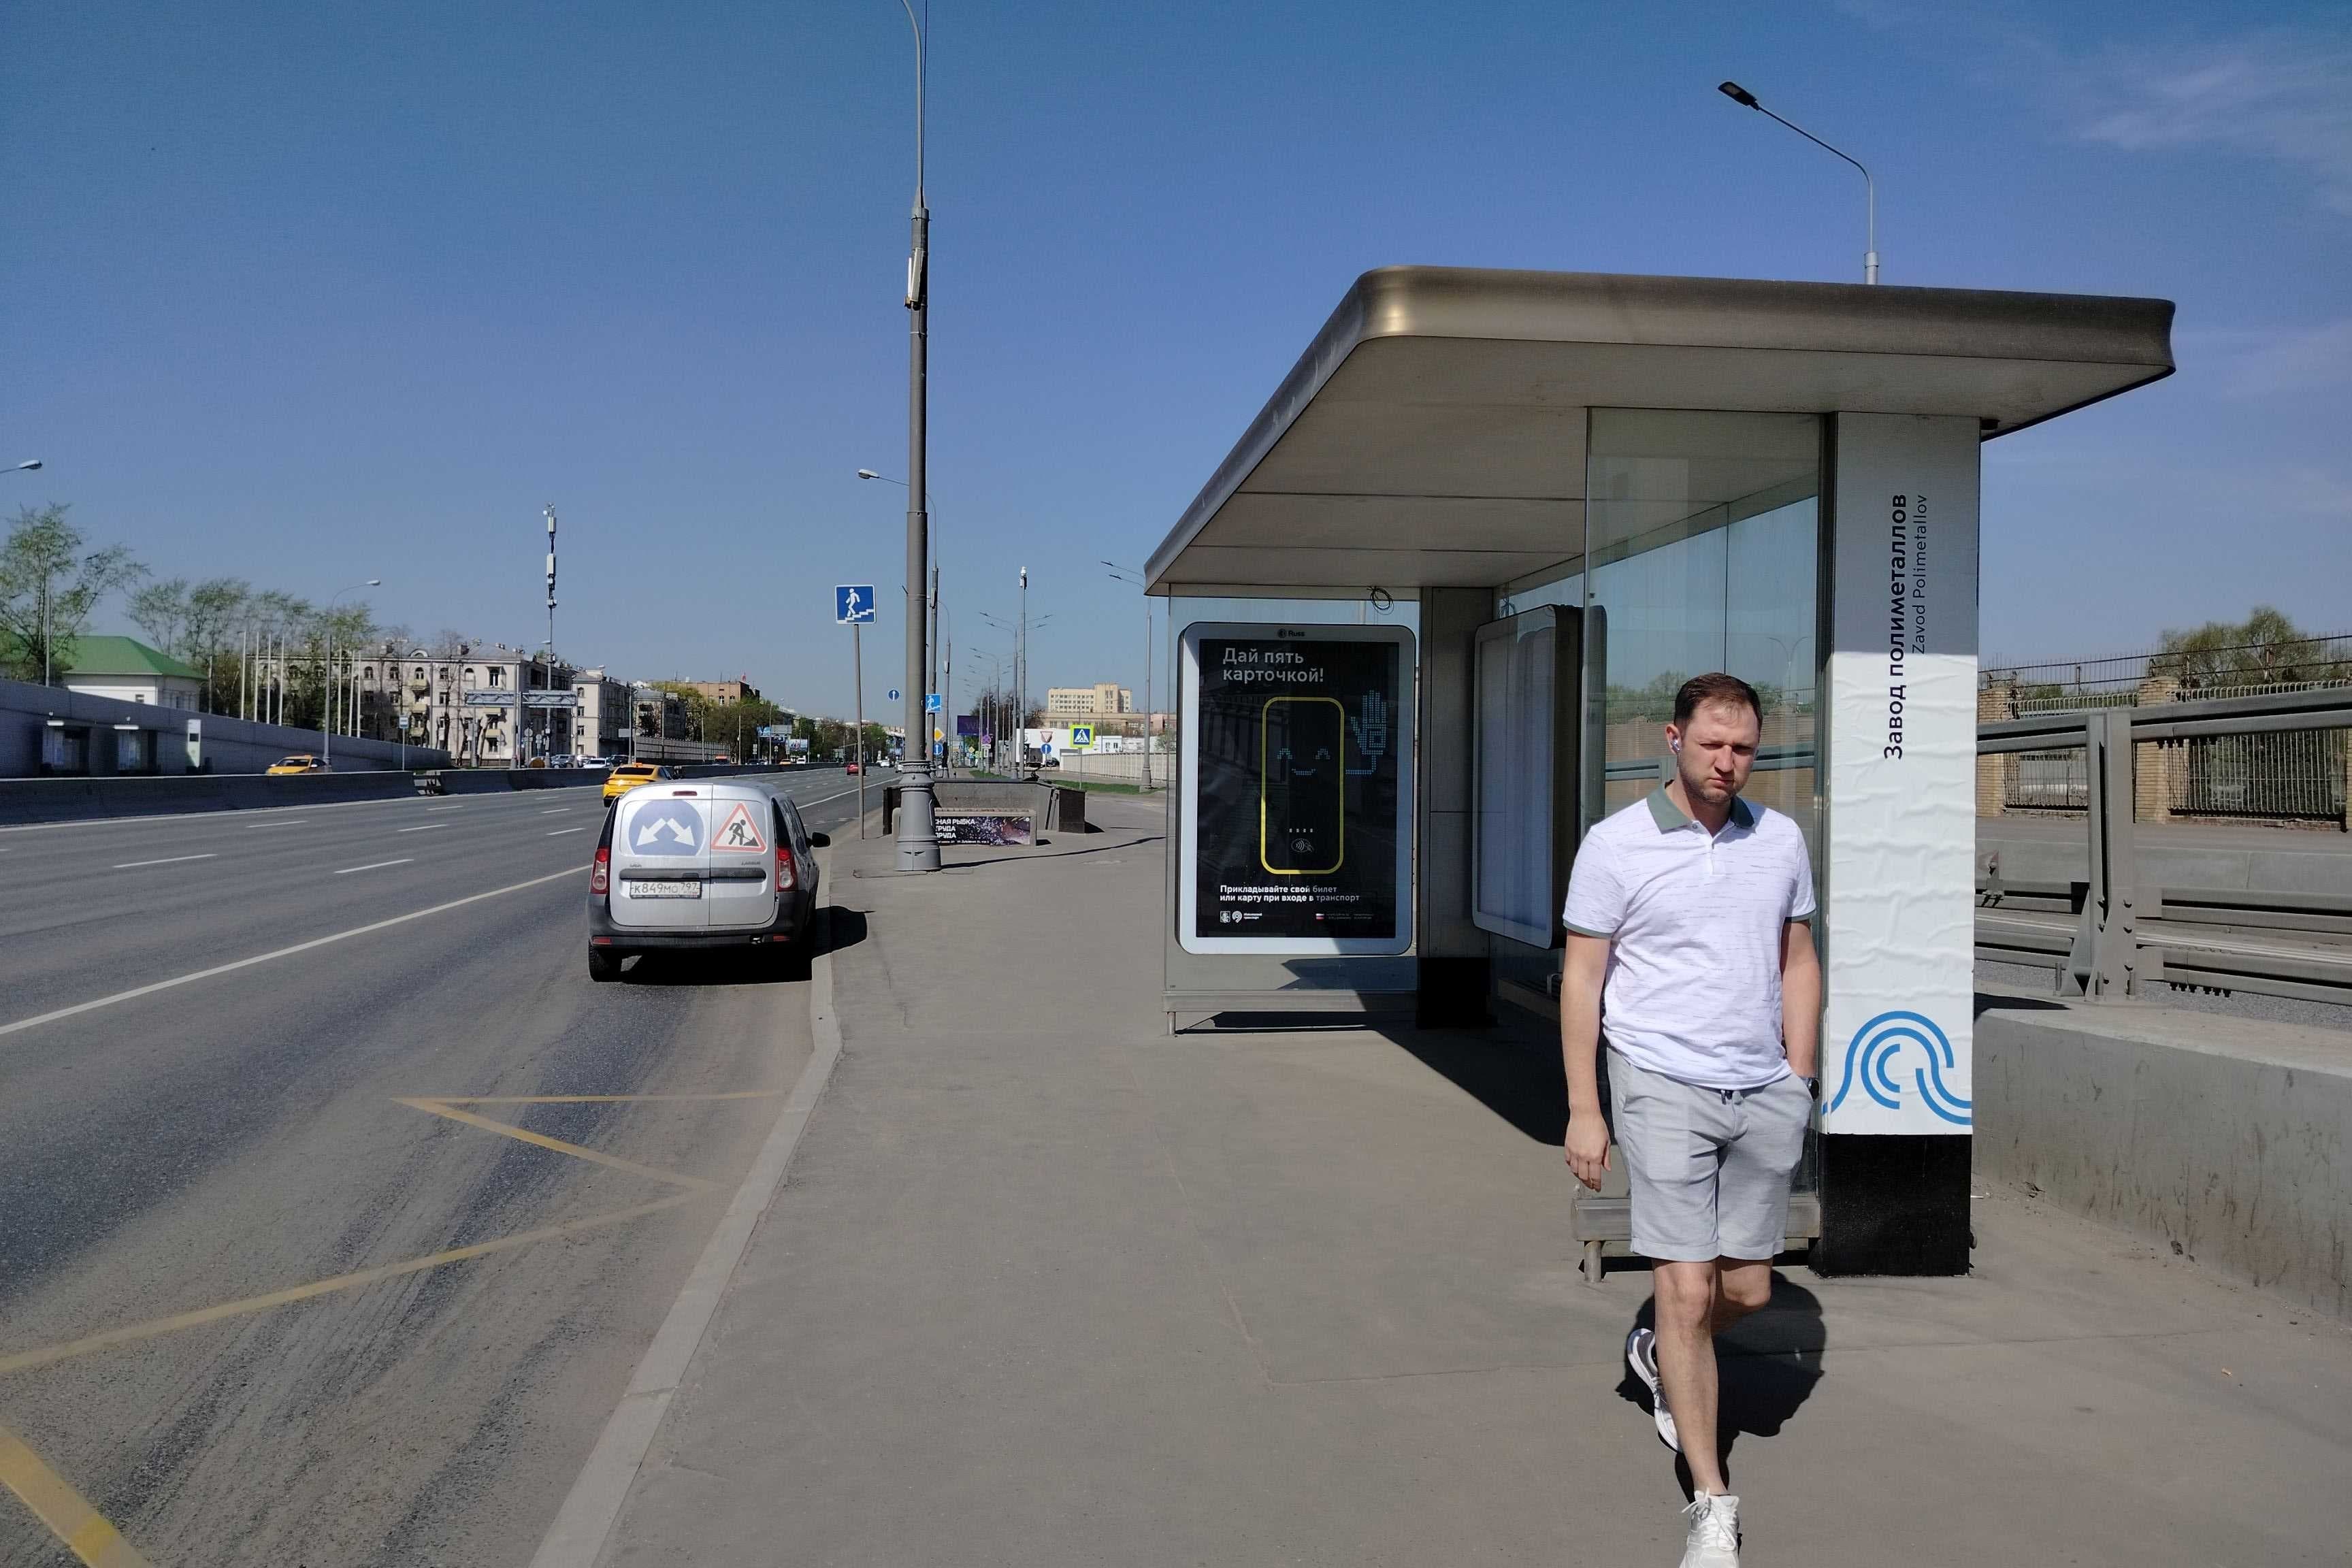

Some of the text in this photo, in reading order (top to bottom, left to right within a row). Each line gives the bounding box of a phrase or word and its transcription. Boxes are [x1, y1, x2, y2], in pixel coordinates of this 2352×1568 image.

[1912, 495, 1927, 654] Zavod Polimetallov
[1884, 495, 1906, 760] Завод полиметаллов
[1223, 647, 1304, 664] Дай пять
[1224, 668, 1324, 684] карточкой!
[1220, 885, 1288, 894] Прикладывайте
[1316, 894, 1360, 902] транспорт
